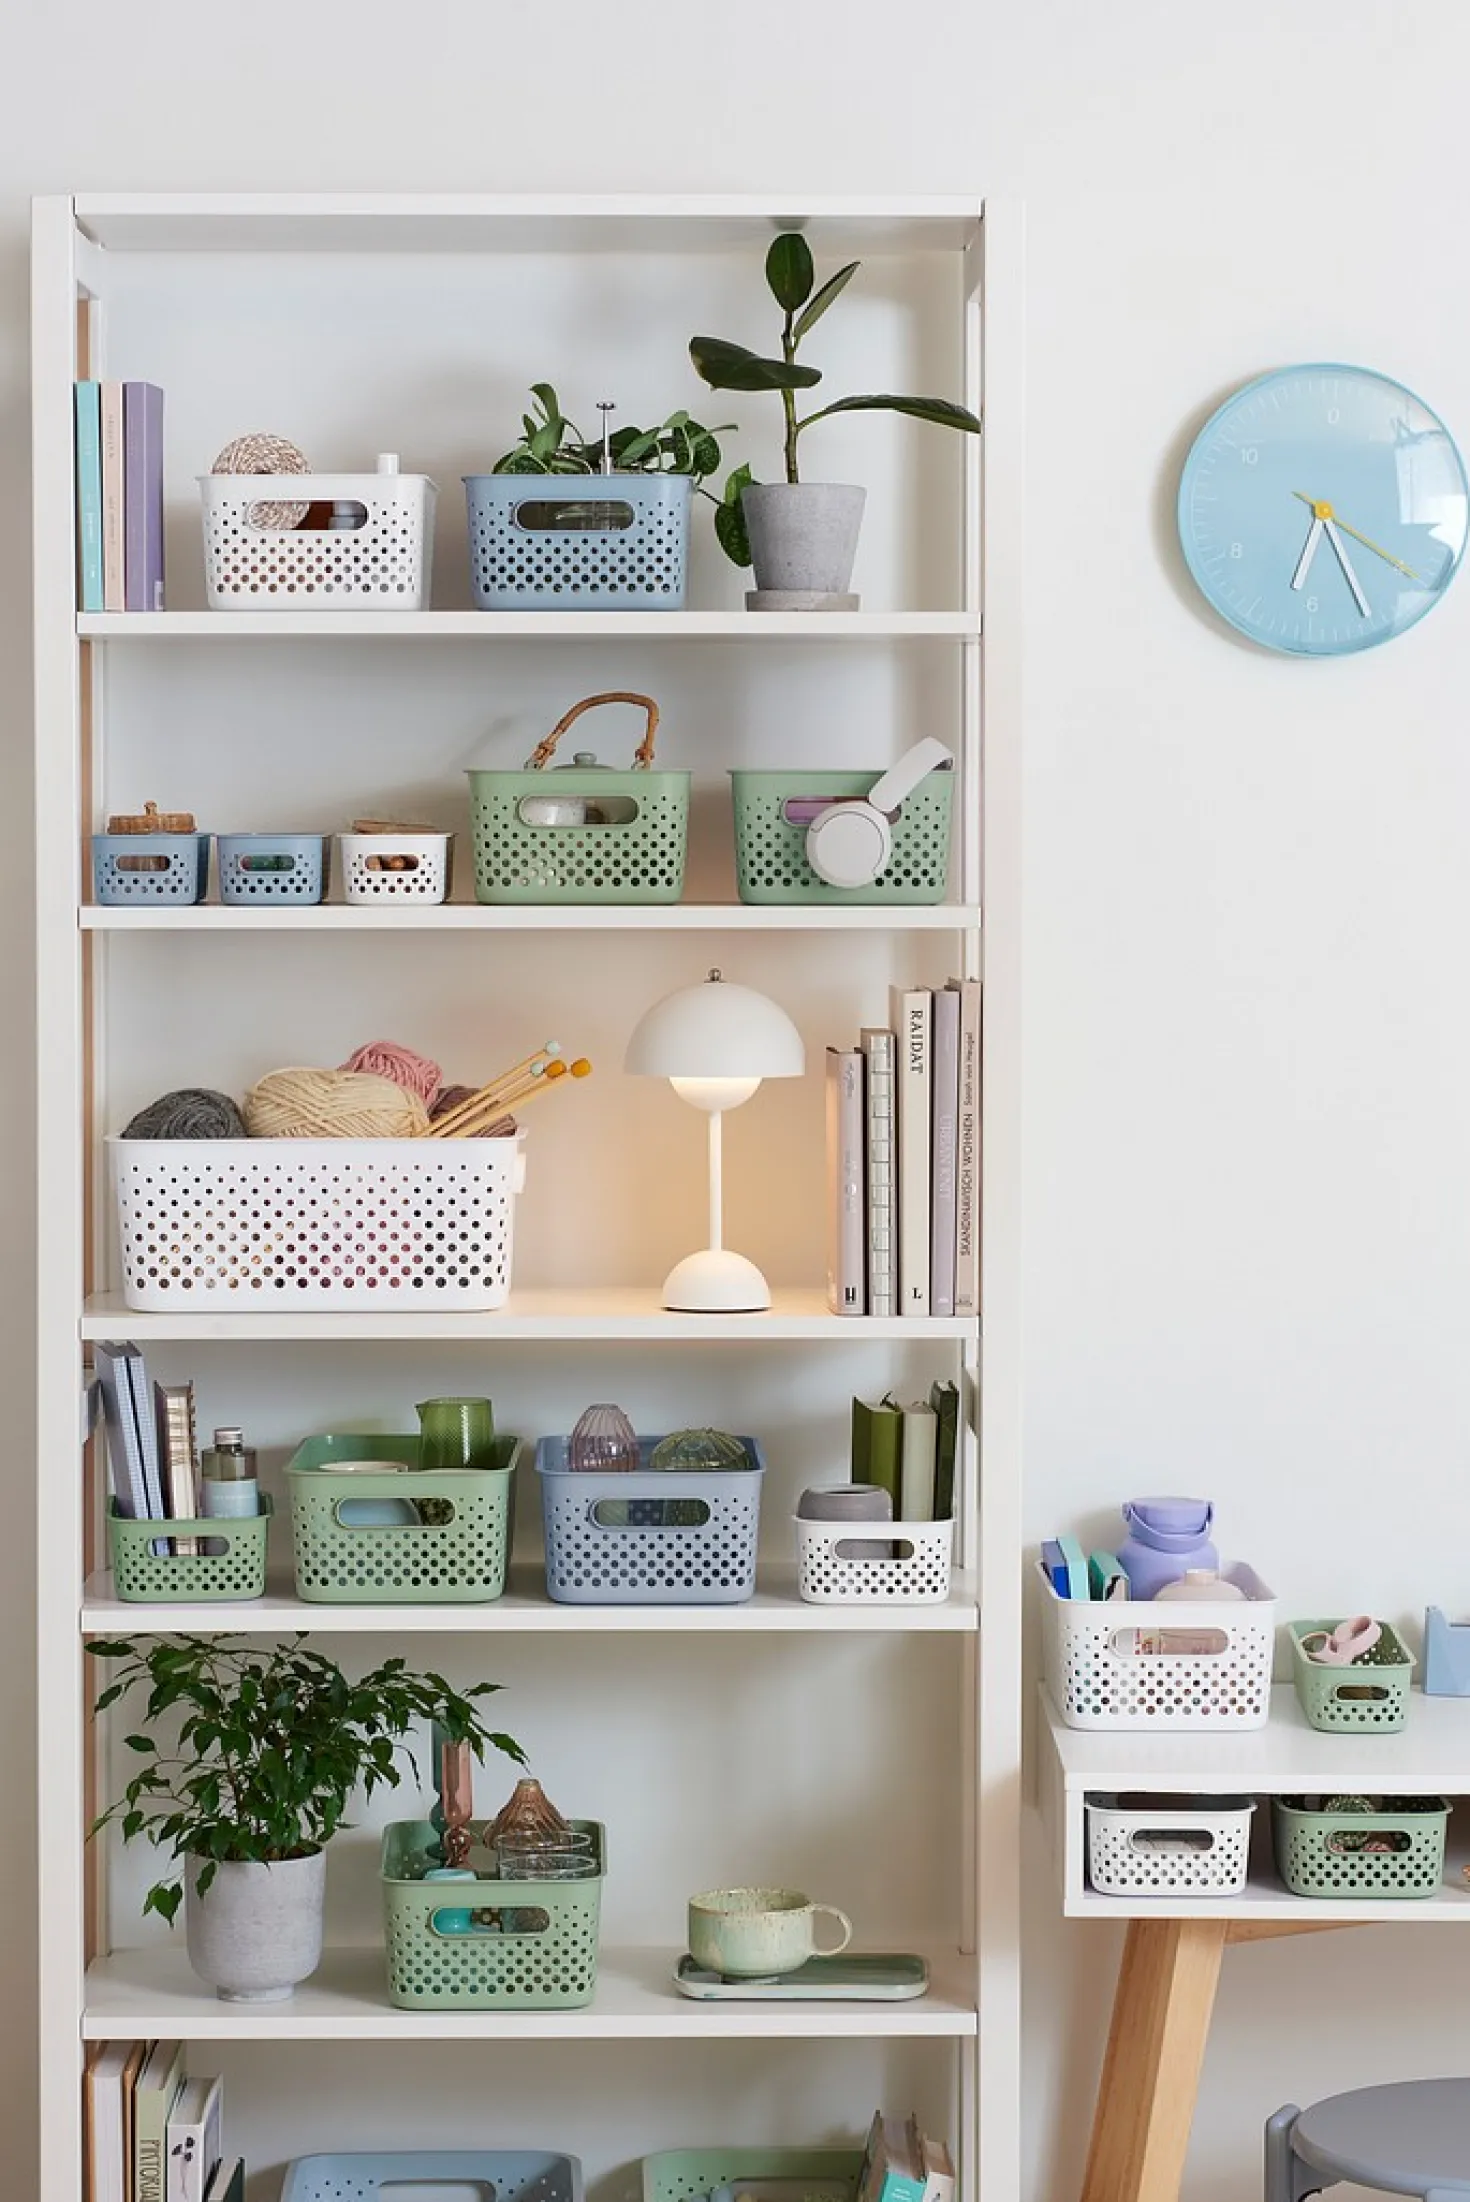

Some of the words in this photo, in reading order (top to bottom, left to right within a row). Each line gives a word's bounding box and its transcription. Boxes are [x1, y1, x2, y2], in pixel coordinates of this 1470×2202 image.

[1242, 449, 1258, 465] 10
[1230, 543, 1243, 558] 8
[1306, 596, 1318, 612] 6
[911, 1010, 924, 1074] RAIDAT
[962, 1113, 973, 1166] WOHNEN
